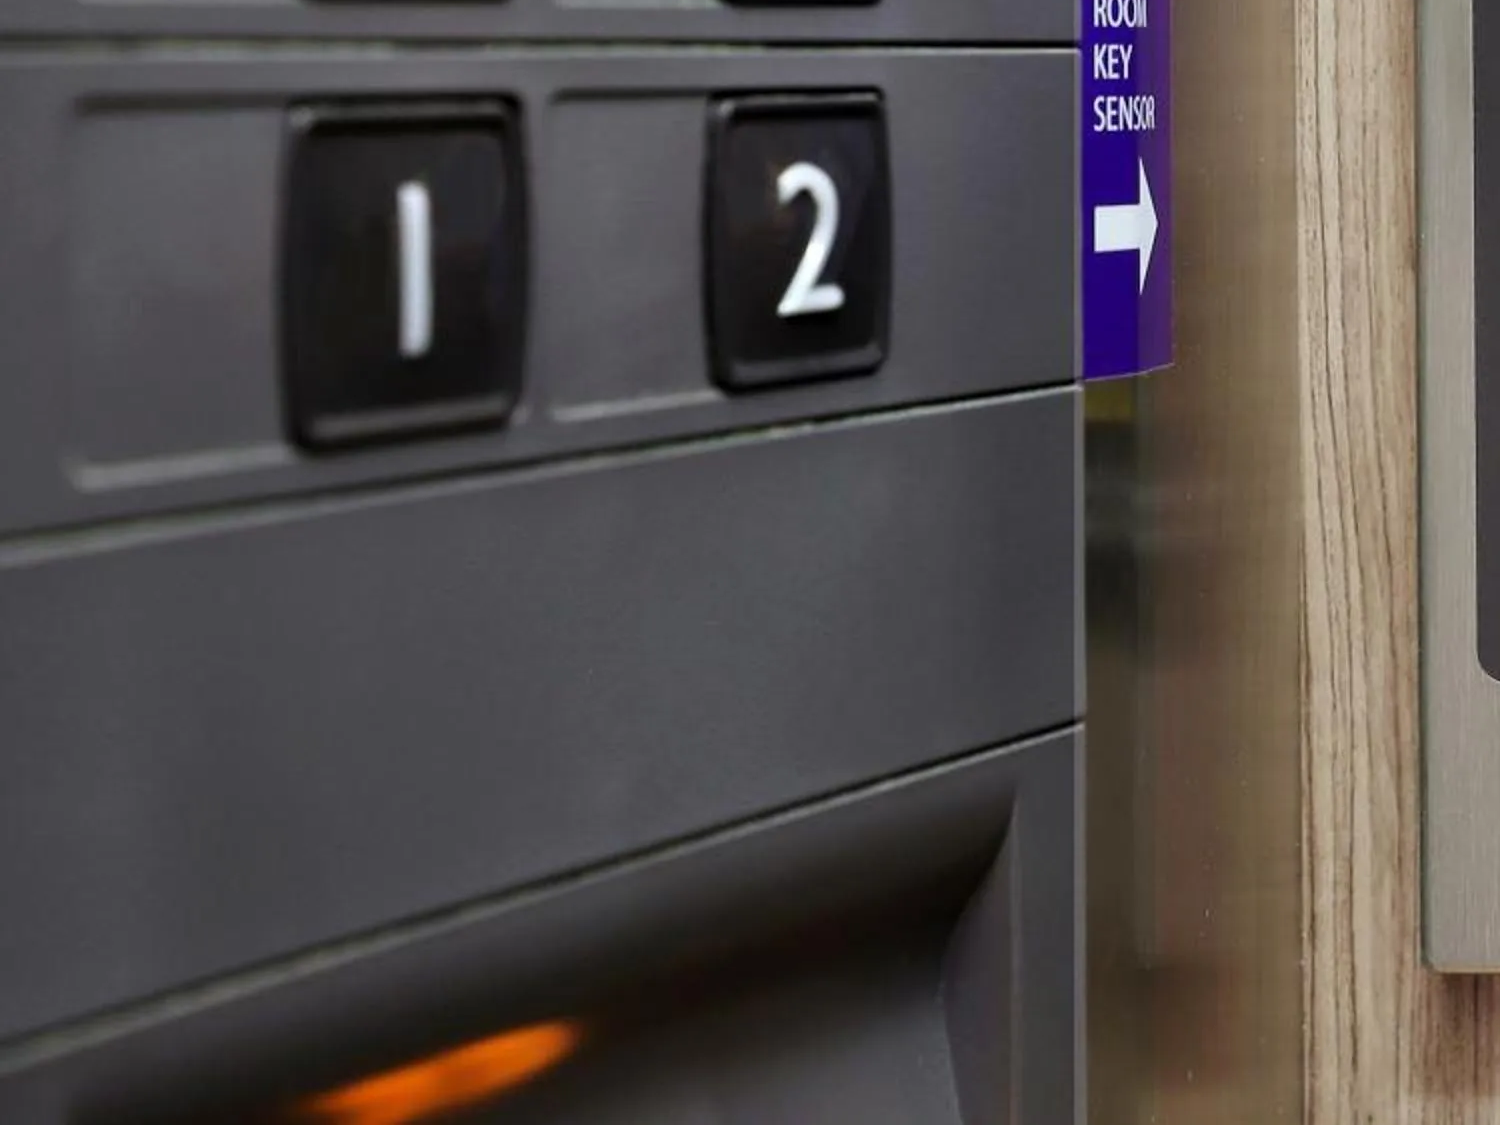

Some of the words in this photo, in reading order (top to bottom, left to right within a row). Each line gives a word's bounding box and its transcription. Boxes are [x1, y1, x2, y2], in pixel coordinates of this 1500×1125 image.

[1093, 43, 1134, 80] KEY
[1093, 94, 1156, 132] SENSOR
[399, 181, 431, 357] 1
[776, 161, 845, 316] 2
